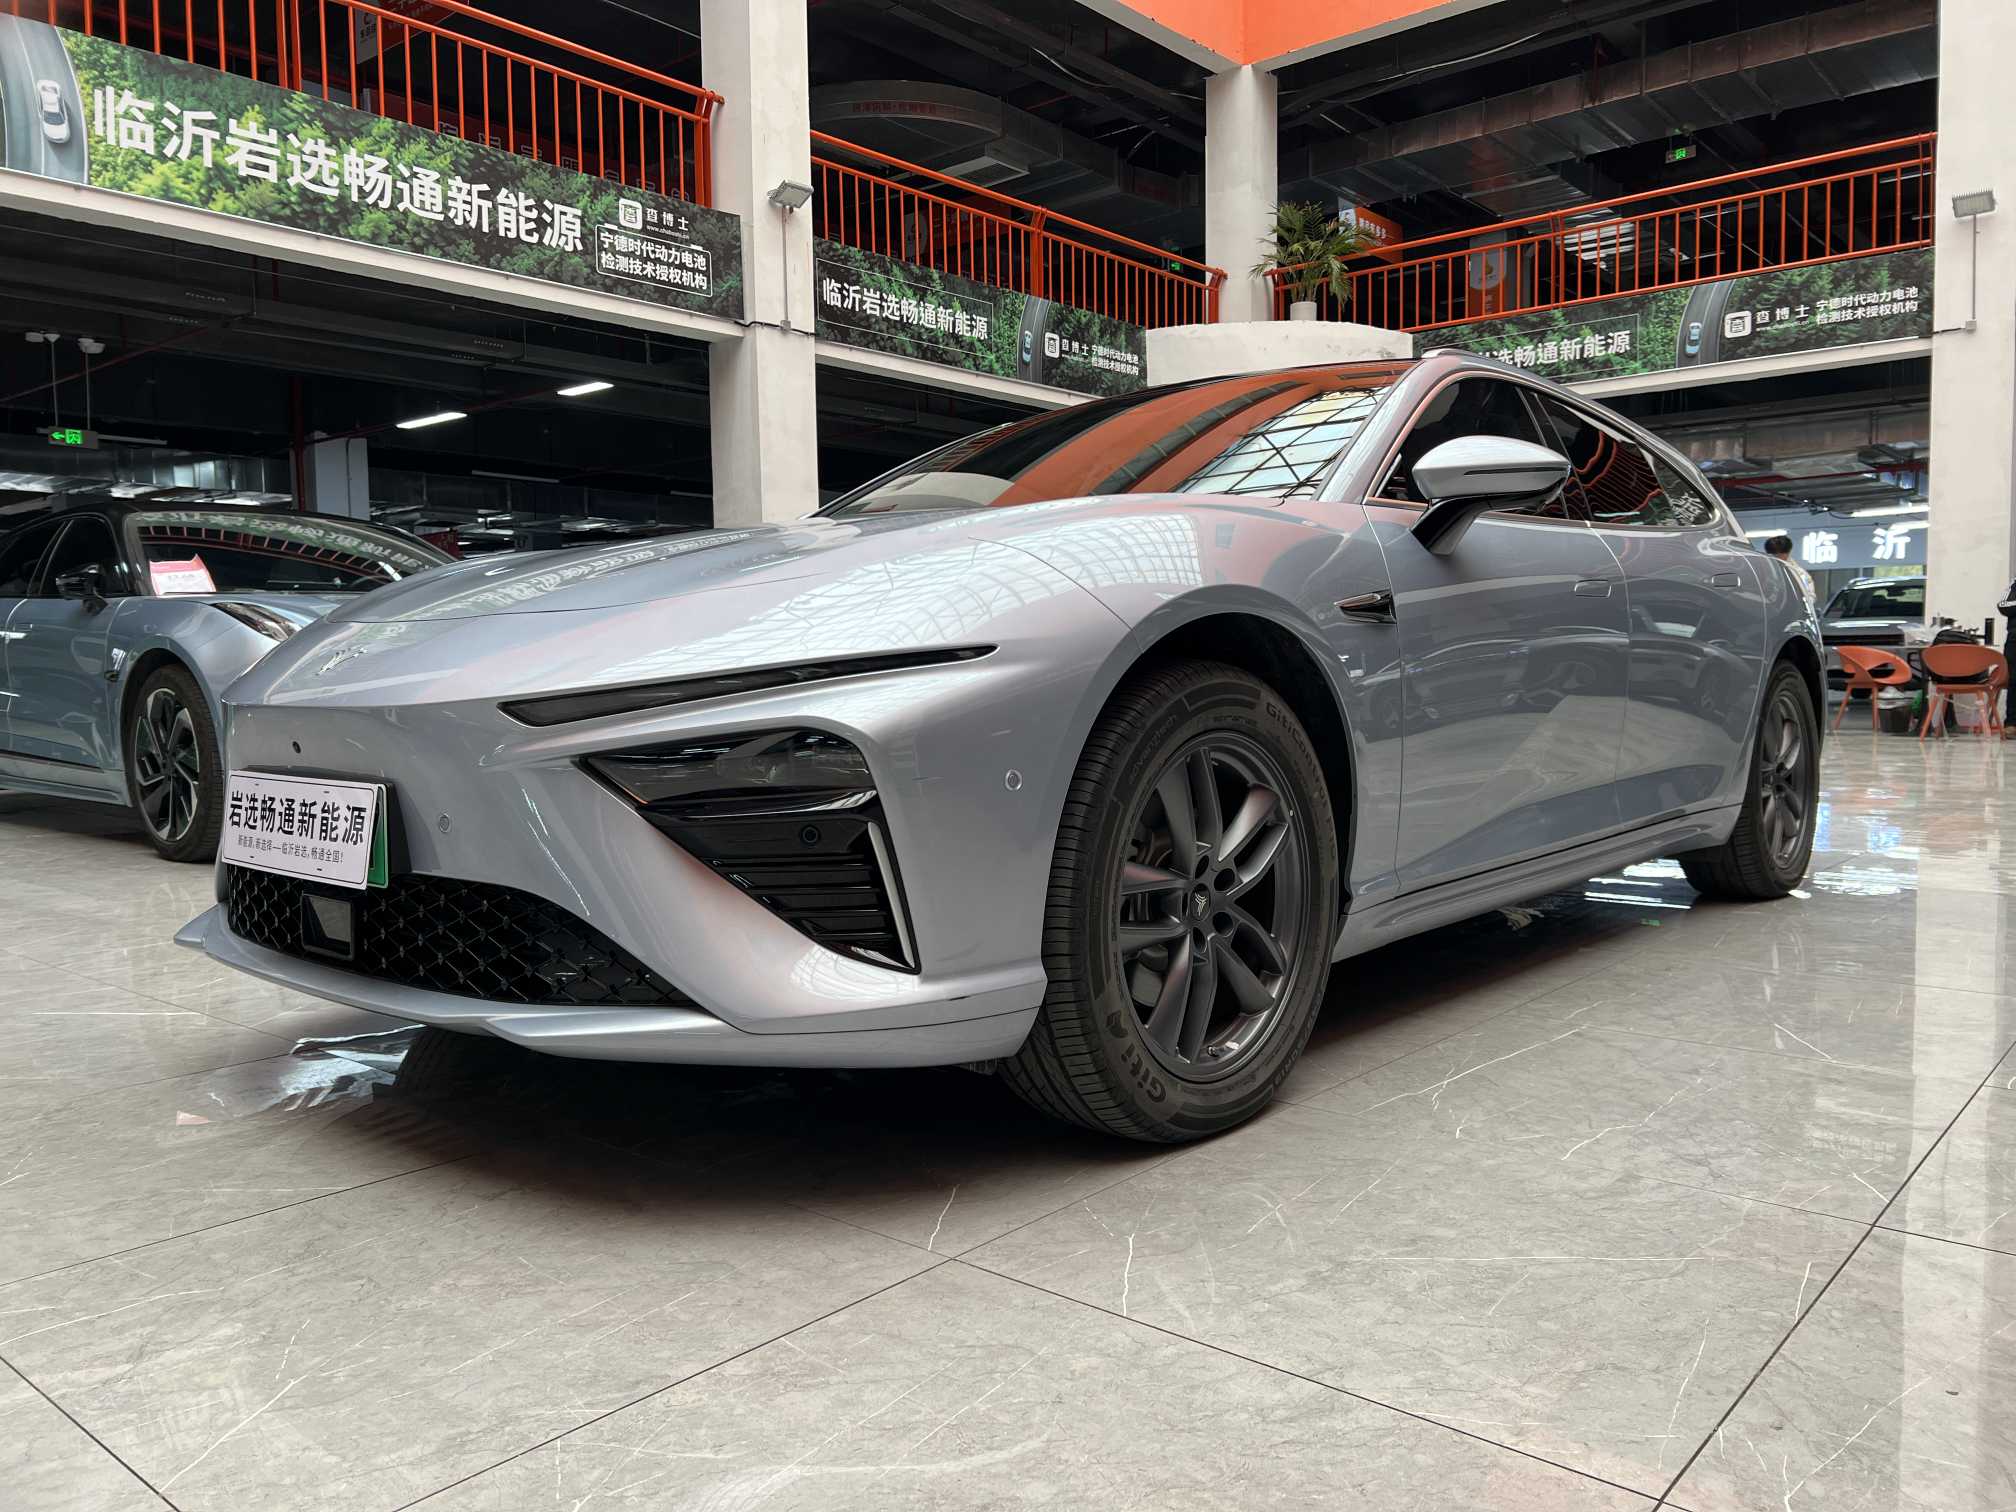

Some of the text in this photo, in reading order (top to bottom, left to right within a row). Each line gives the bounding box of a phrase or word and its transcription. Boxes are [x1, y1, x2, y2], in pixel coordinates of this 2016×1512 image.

[92, 84, 584, 253] 临沂岩选畅通新能源
[646, 207, 689, 231] 查博士
[599, 231, 707, 271] 宁德时代动力电池
[600, 251, 708, 290] 检测技术授权机构
[822, 277, 989, 341] 临沂岩选畅通新能源
[1755, 305, 1810, 324] 查博士
[1815, 286, 1919, 310] 宁德时代动力电池
[1815, 300, 1919, 325] 检测技术授权机构
[1480, 329, 1632, 368] 选畅通新能源
[1801, 527, 1912, 564] 临沂
[228, 790, 368, 846] 岩选畅通新能源
[1120, 1042, 1167, 1103] Giti
